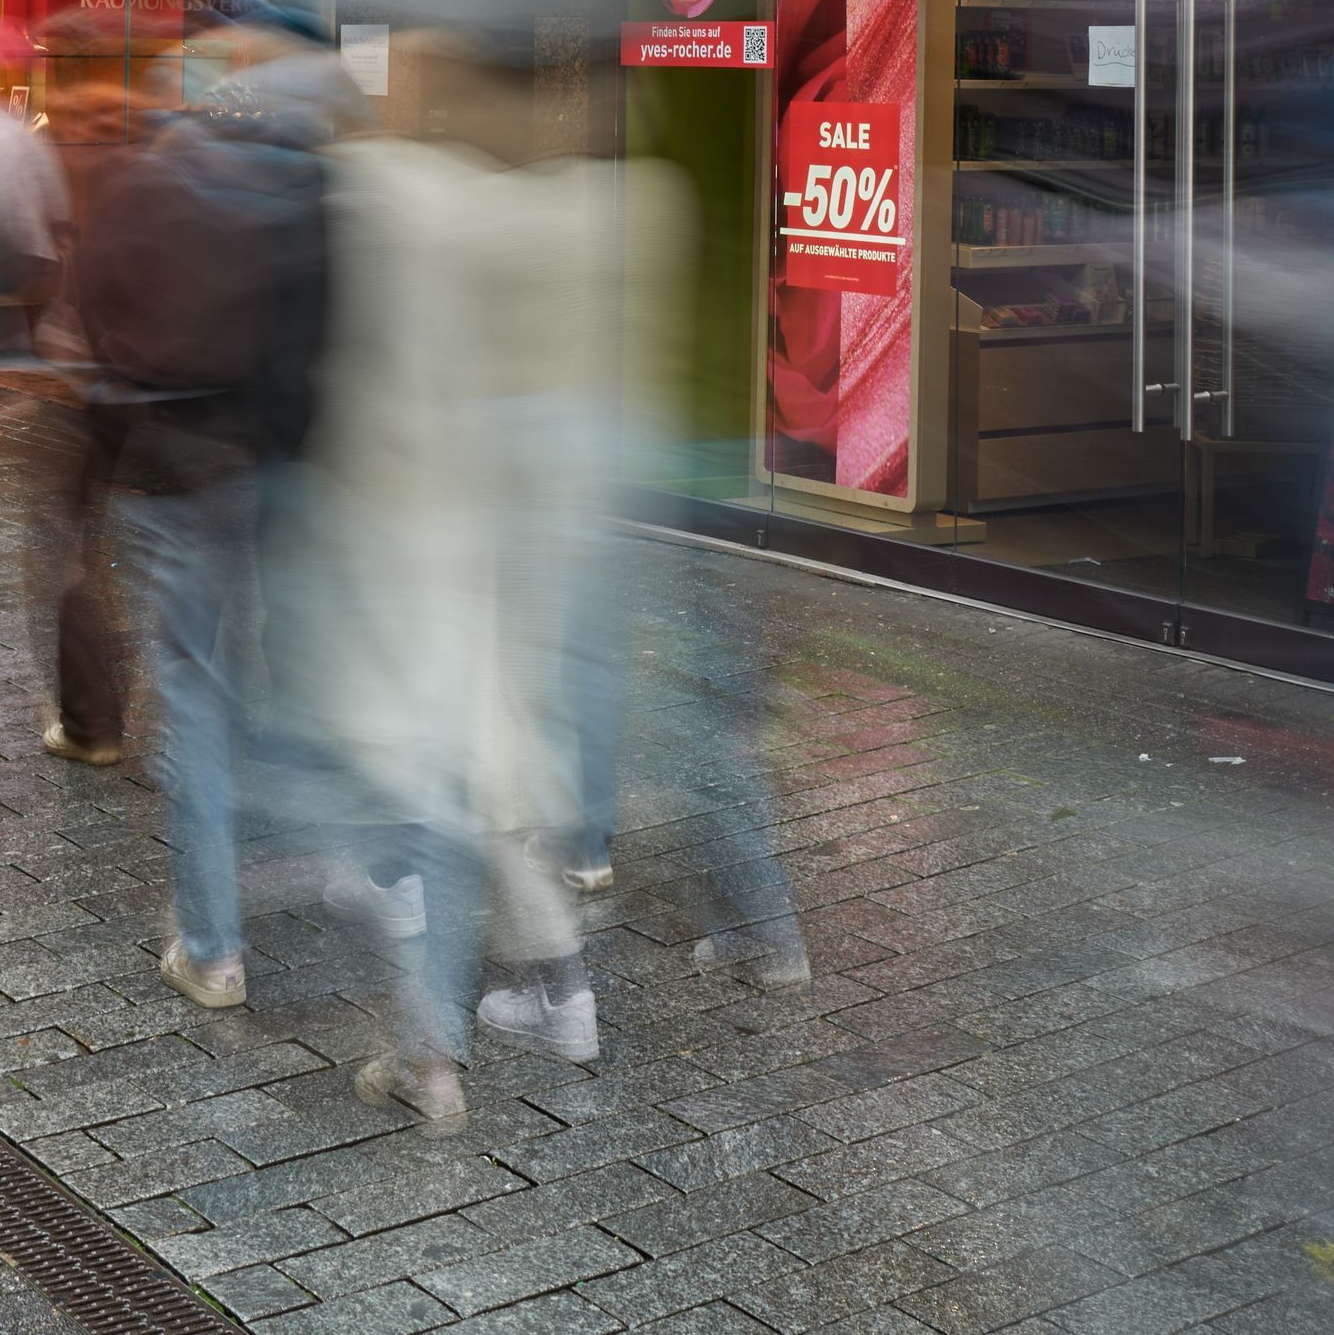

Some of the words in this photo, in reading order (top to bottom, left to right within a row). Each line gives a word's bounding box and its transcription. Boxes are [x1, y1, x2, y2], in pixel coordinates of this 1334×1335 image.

[651, 26, 677, 38] Finden
[678, 26, 691, 38] Sie
[692, 28, 707, 38] uns
[707, 26, 721, 38] auf
[641, 41, 732, 62] yves-rocher.de
[819, 121, 871, 150] SALE
[783, 164, 897, 233] -50%
[789, 243, 805, 254] AUF
[805, 244, 857, 260] AUSGEWÄHLTE
[857, 250, 897, 263] PRODUKTE
